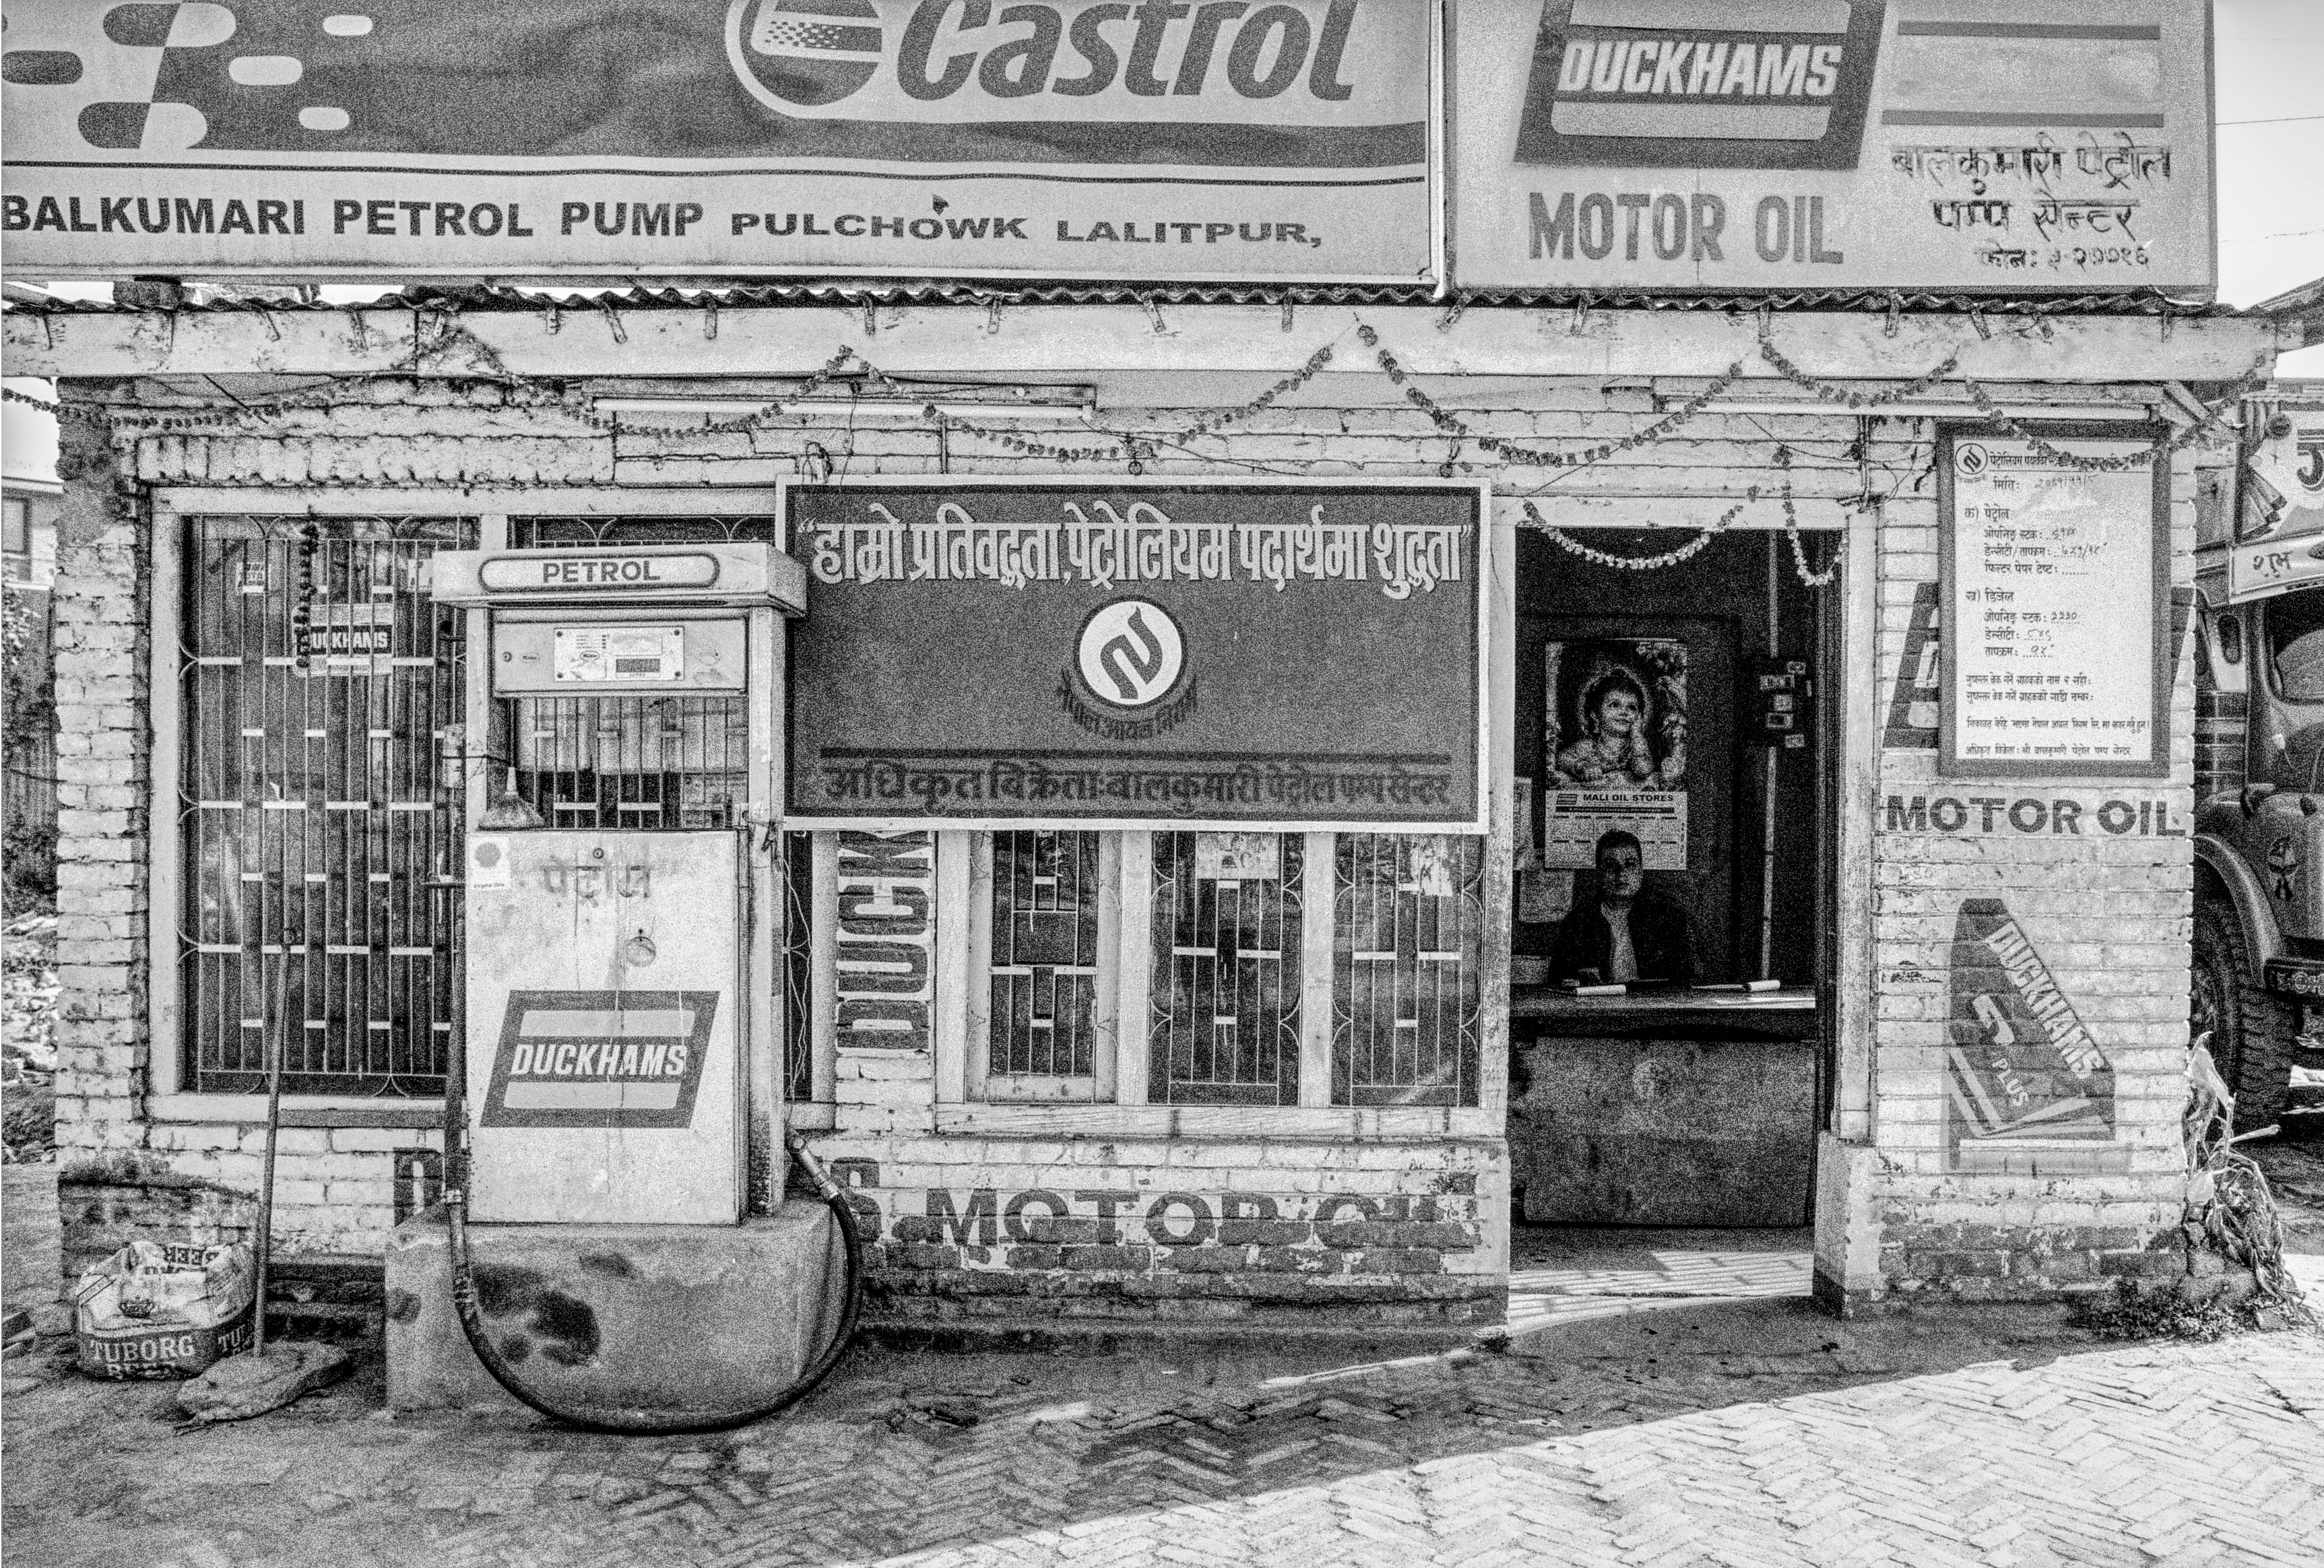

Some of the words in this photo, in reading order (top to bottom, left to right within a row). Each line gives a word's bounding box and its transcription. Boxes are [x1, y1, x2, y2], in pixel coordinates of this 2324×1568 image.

[897, 0, 1355, 100] Castrol
[1557, 40, 1843, 98] DUCKHAMS
[2, 196, 304, 235] BALKUMARI
[333, 199, 534, 237] PETROL
[560, 201, 704, 236] PUMP
[731, 212, 1029, 241] PULCHOWK
[1056, 220, 1322, 248] LALITPUR,
[1528, 192, 1726, 262] MOTOR
[1754, 195, 1844, 265] OIL
[542, 560, 661, 584] PETROL
[302, 631, 389, 649] UKHAMS
[1582, 793, 1609, 802] MALI
[1612, 793, 1628, 802] OIL
[1632, 793, 1674, 802] STORES
[1886, 795, 2082, 835] MOTOR
[2097, 799, 2186, 837] OIL
[1985, 919, 2104, 1080] DUCKHAMS
[509, 1043, 687, 1078] DUCKHAMS
[1991, 1057, 2029, 1106] PLUS
[90, 1335, 195, 1363] TUBORG
